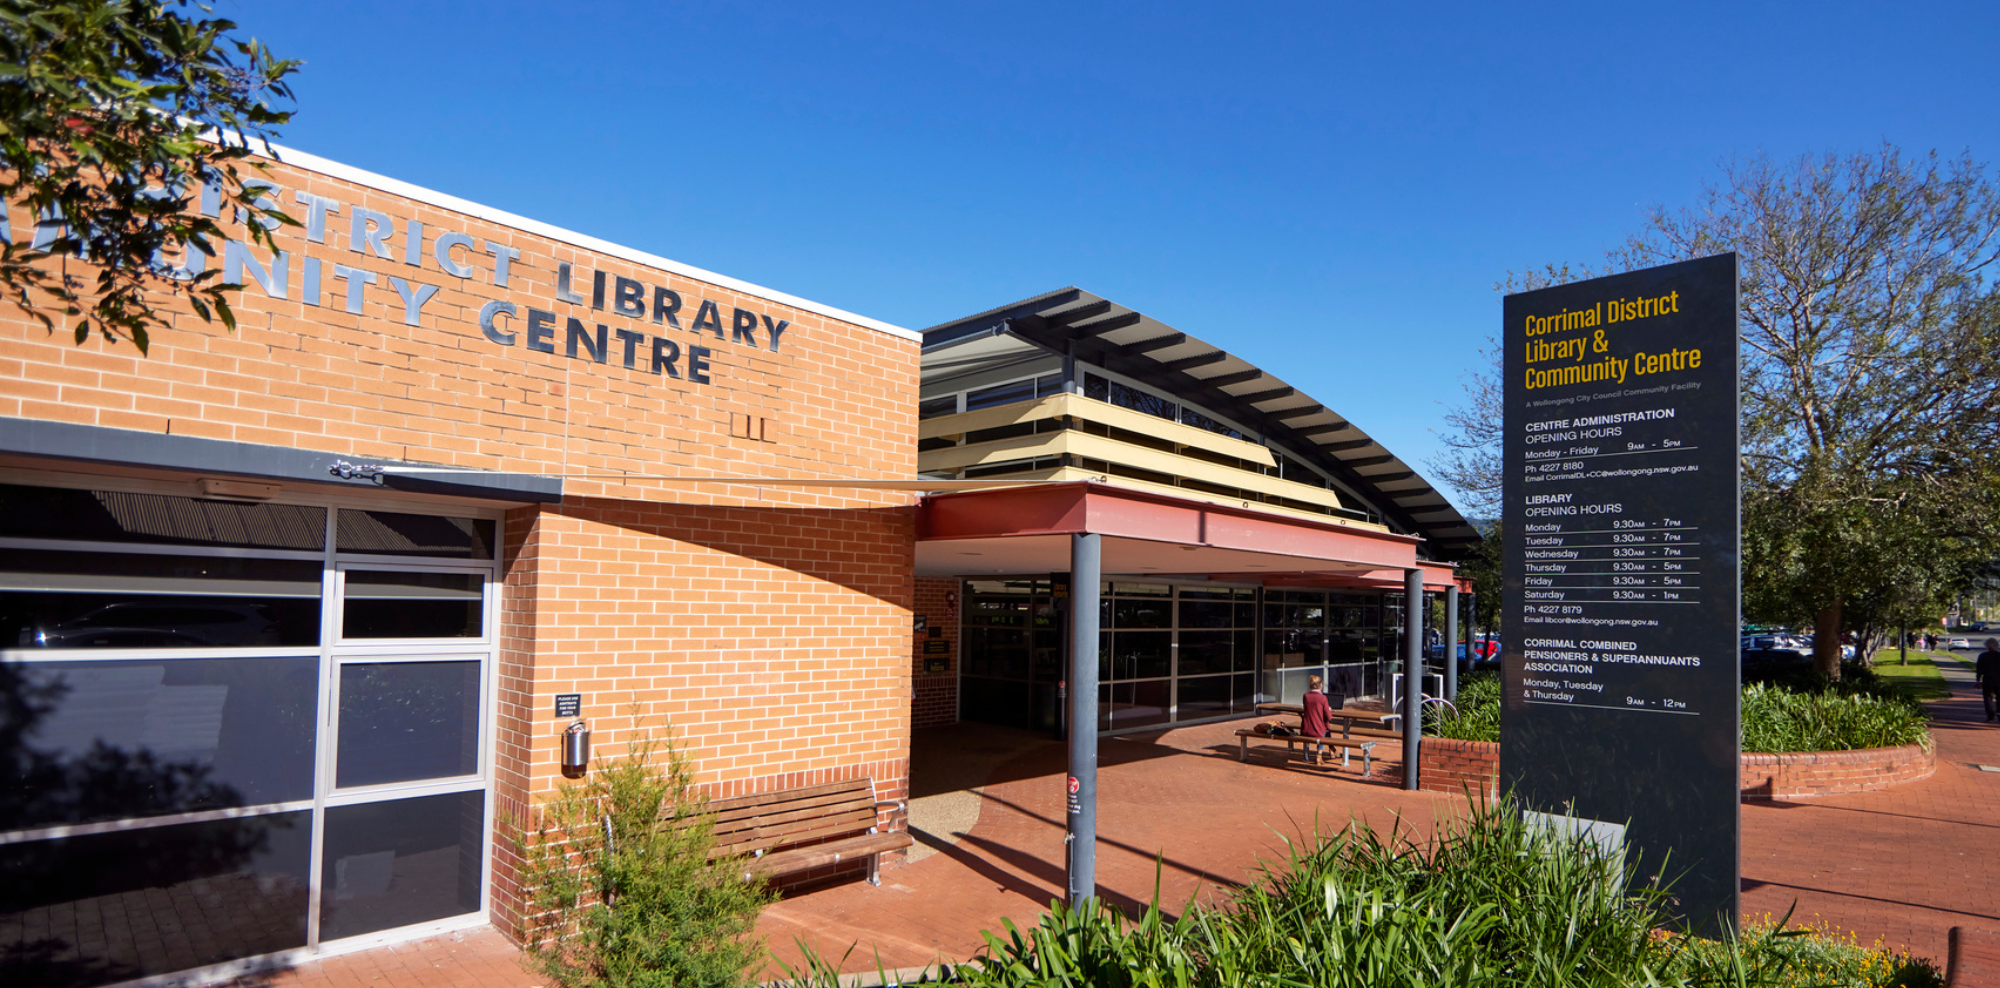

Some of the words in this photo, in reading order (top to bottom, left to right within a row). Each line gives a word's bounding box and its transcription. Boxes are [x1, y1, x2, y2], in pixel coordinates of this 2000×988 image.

[555, 260, 791, 355] LIBRARY
[1525, 302, 1601, 337] Corrimal
[1607, 290, 1680, 324] District
[479, 299, 712, 386] CENTRE
[1525, 337, 1587, 363] Library
[1592, 329, 1609, 353] &
[1525, 355, 1629, 390] Community
[1634, 347, 1702, 376] Centre
[1533, 396, 1575, 407] Wollongong
[1576, 394, 1591, 402] City
[1592, 390, 1622, 400] Council
[1623, 385, 1669, 396] Community
[1671, 381, 1702, 392] Facility
[1525, 419, 1570, 432] CENTRE
[1573, 408, 1675, 427] ADMINISTRATION
[1525, 430, 1577, 444] OPENING
[1580, 426, 1623, 440] HOURS
[1525, 449, 1561, 460] Monday
[1569, 445, 1599, 456] Friday
[1627, 442, 1645, 451] 9AM
[1663, 438, 1681, 448] 5PM
[1525, 465, 1537, 474] Ph
[1539, 463, 1561, 473] 4227
[1562, 461, 1584, 471] 8180
[1525, 474, 1545, 483] Email
[1525, 493, 1573, 505] LIBRARY
[1525, 505, 1577, 517] OPENING
[1580, 503, 1623, 515] HOURS
[1525, 522, 1562, 533] Monday
[1613, 519, 1646, 529] 9.30AM
[1663, 518, 1681, 527] 7PM
[1525, 536, 1564, 547] Tuesday
[1613, 533, 1646, 543] 9.30AM
[1663, 532, 1681, 541] 7PM
[1525, 550, 1579, 560] Wednesday
[1613, 547, 1646, 557] 9.30AM
[1663, 547, 1681, 556] 7PM
[1525, 563, 1567, 573] Thursday
[1613, 562, 1646, 571] 9.30AM
[1664, 561, 1682, 571] 5PM
[1525, 576, 1553, 587] Friday
[1613, 576, 1646, 586] 9.30AM
[1664, 576, 1682, 585] 5PM
[1524, 590, 1565, 600] Saturday
[1613, 590, 1646, 600] 9.30AM
[1663, 590, 1680, 600] 1PM
[1524, 605, 1536, 614] Ph
[1538, 605, 1560, 614] 4227
[1562, 605, 1583, 615] 8179
[1524, 615, 1544, 624] Email
[1545, 616, 1659, 628] libcor@wollongong.nsw.gov.au
[1524, 638, 1577, 649] CORRIMAL
[1579, 639, 1638, 651] COMBINED
[1524, 650, 1589, 662] PENSIONERS
[1592, 653, 1599, 662] &
[1601, 653, 1701, 667] SUPERANNUANTS
[1524, 662, 1593, 674] ASSOCIATION
[1523, 678, 1562, 690] Monday,
[1563, 680, 1604, 693] Tuesday
[1523, 689, 1531, 698] &
[1532, 690, 1575, 702] Thursday
[1626, 696, 1645, 706] 9AM
[1663, 698, 1687, 709] 12PM
